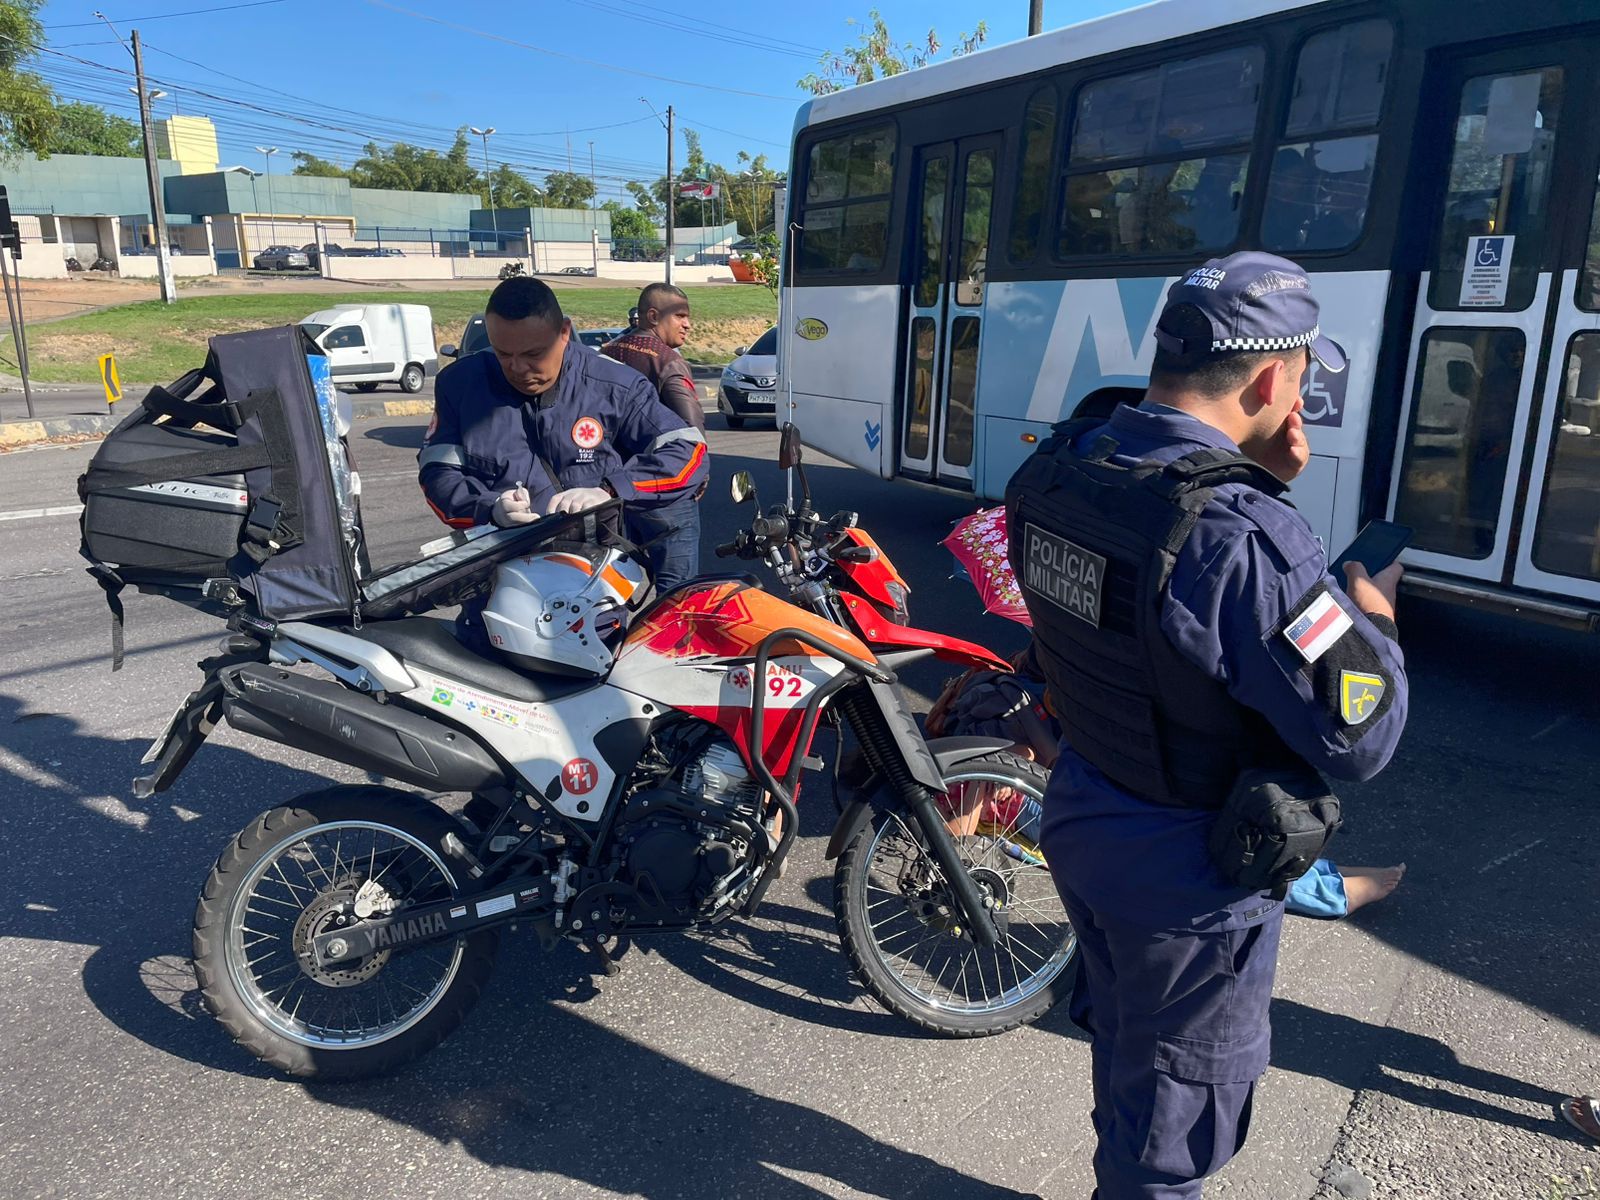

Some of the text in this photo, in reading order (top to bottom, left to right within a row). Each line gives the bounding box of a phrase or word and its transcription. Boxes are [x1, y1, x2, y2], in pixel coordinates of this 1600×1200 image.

[1030, 534, 1097, 590] POLÍCIA
[1029, 562, 1096, 620] MILITAR
[767, 664, 802, 676] AMU
[767, 677, 802, 697] 92
[568, 762, 590, 775] MT
[569, 773, 592, 790] 11
[364, 912, 448, 949] YAMAHA
